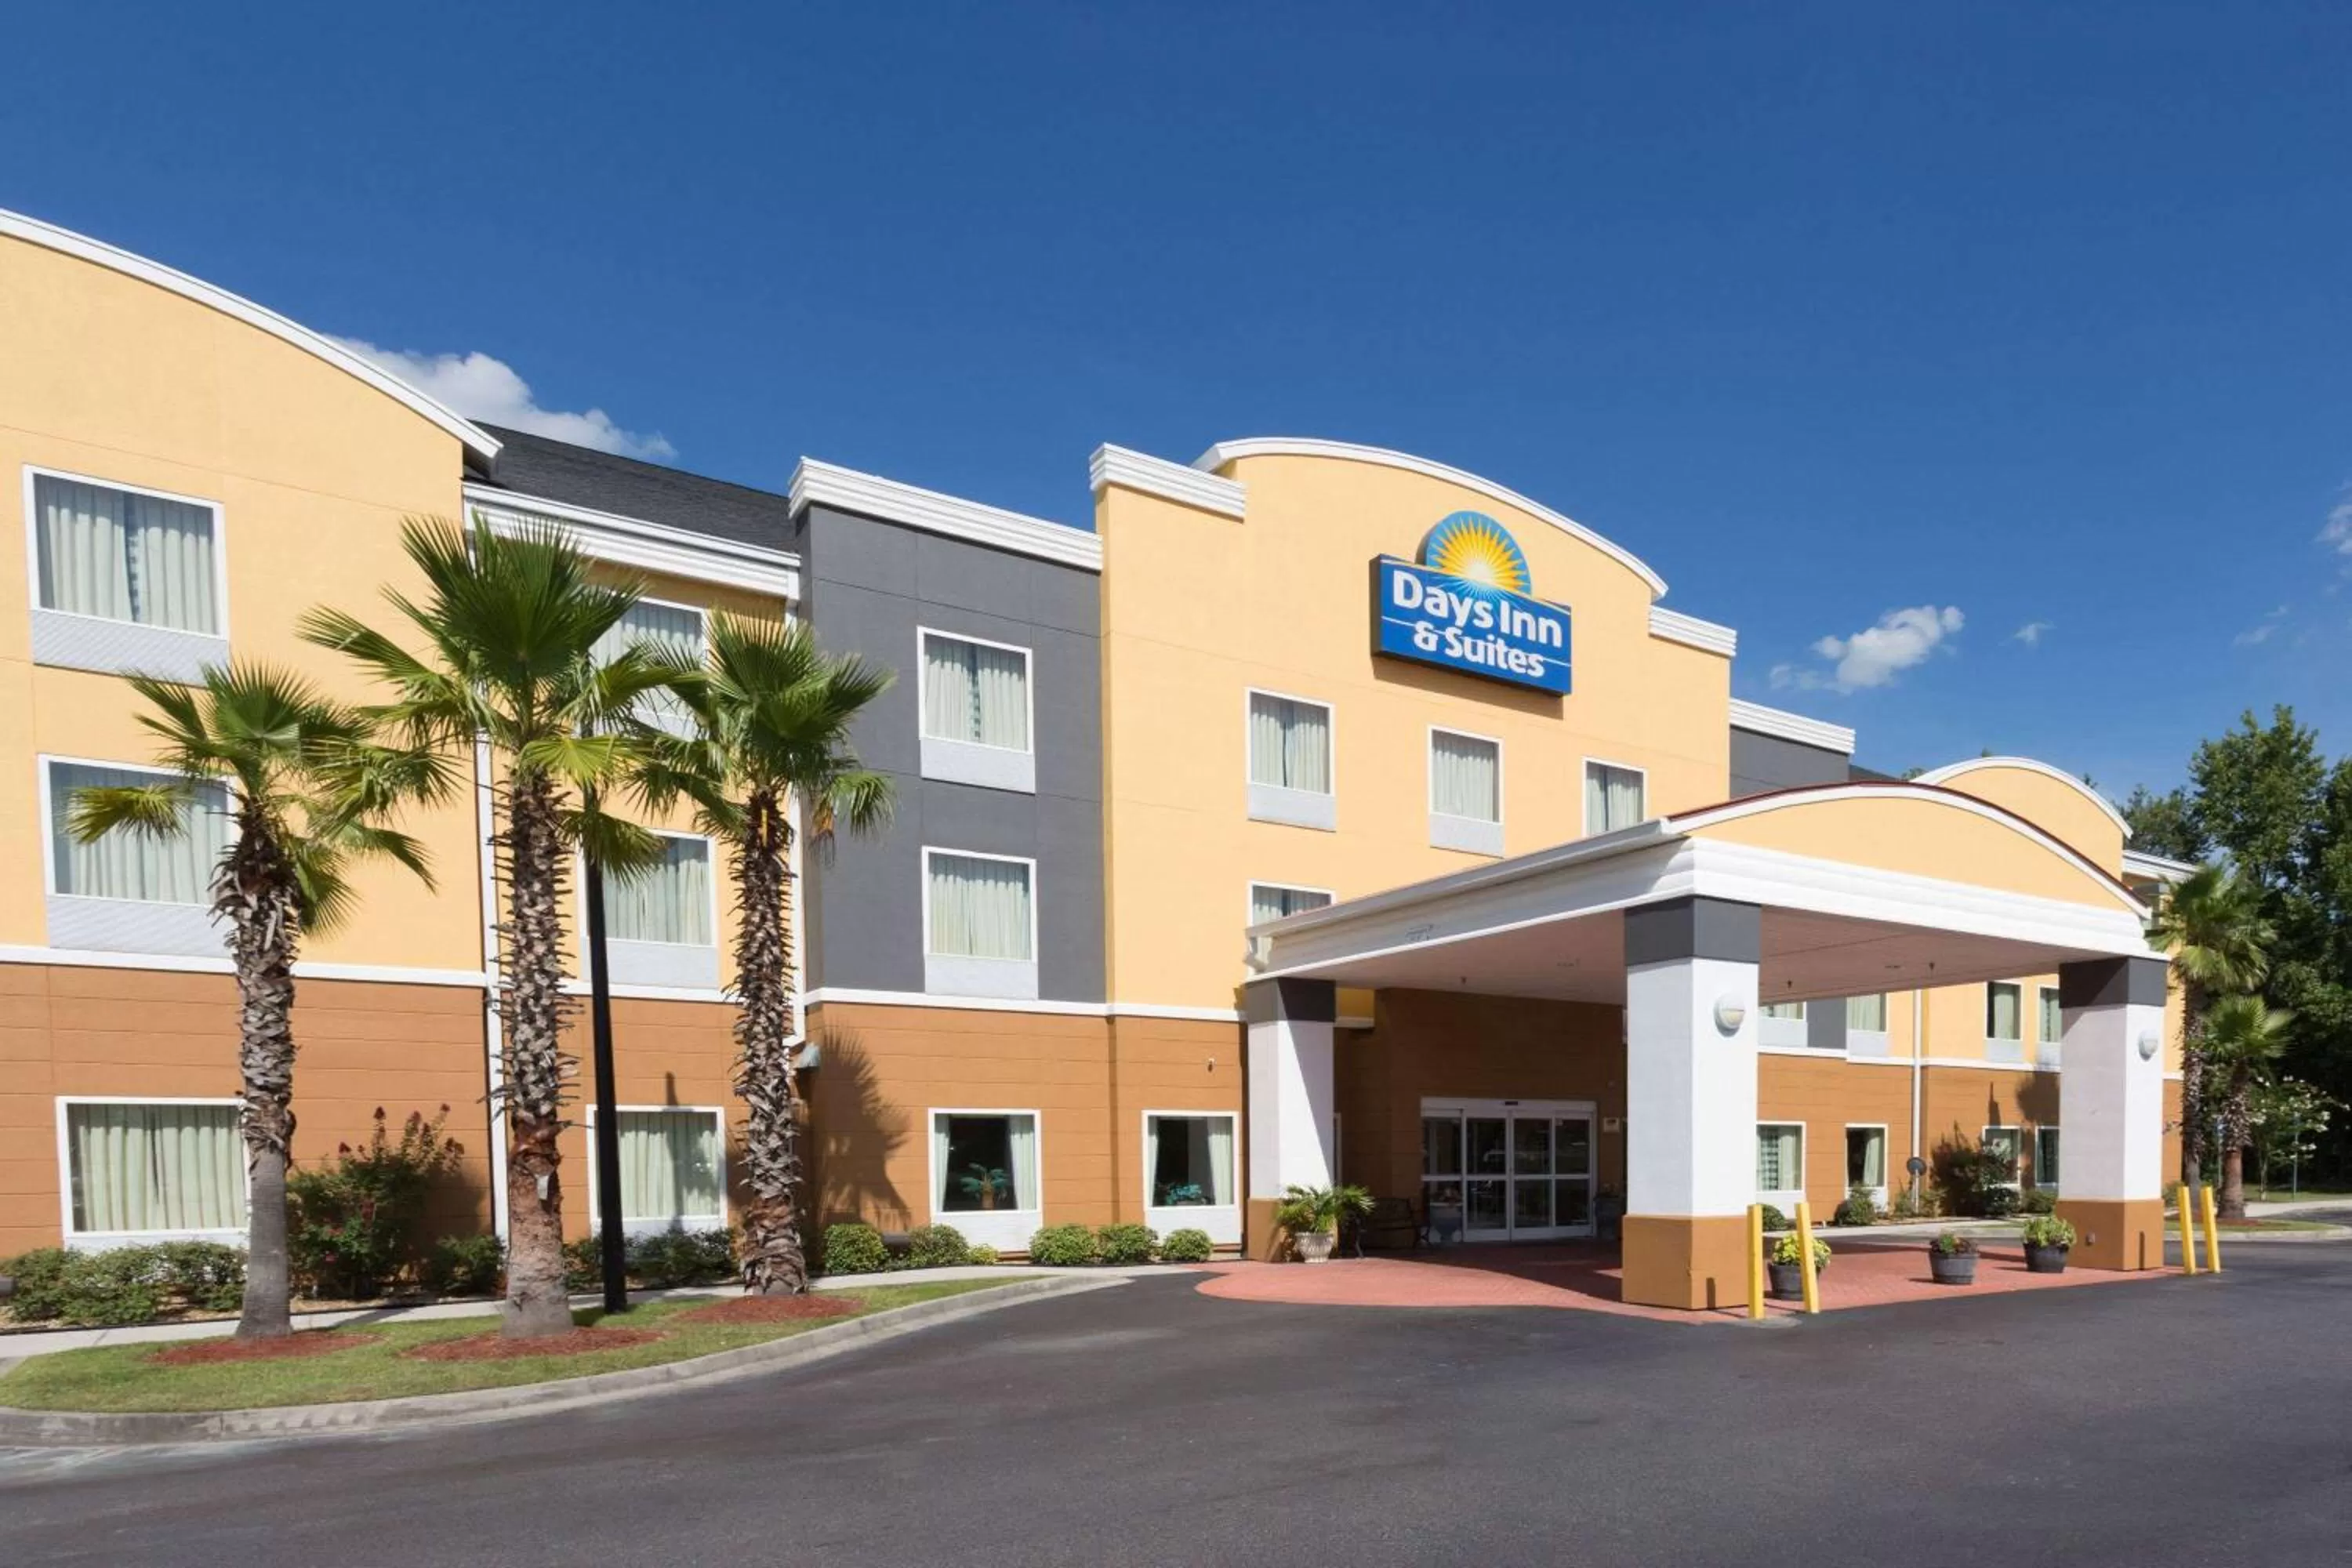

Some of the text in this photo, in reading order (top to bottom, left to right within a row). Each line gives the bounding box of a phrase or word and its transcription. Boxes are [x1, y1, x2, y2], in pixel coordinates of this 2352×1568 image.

[1393, 570, 1563, 648] Days Inn
[1414, 620, 1545, 677] & Suites
